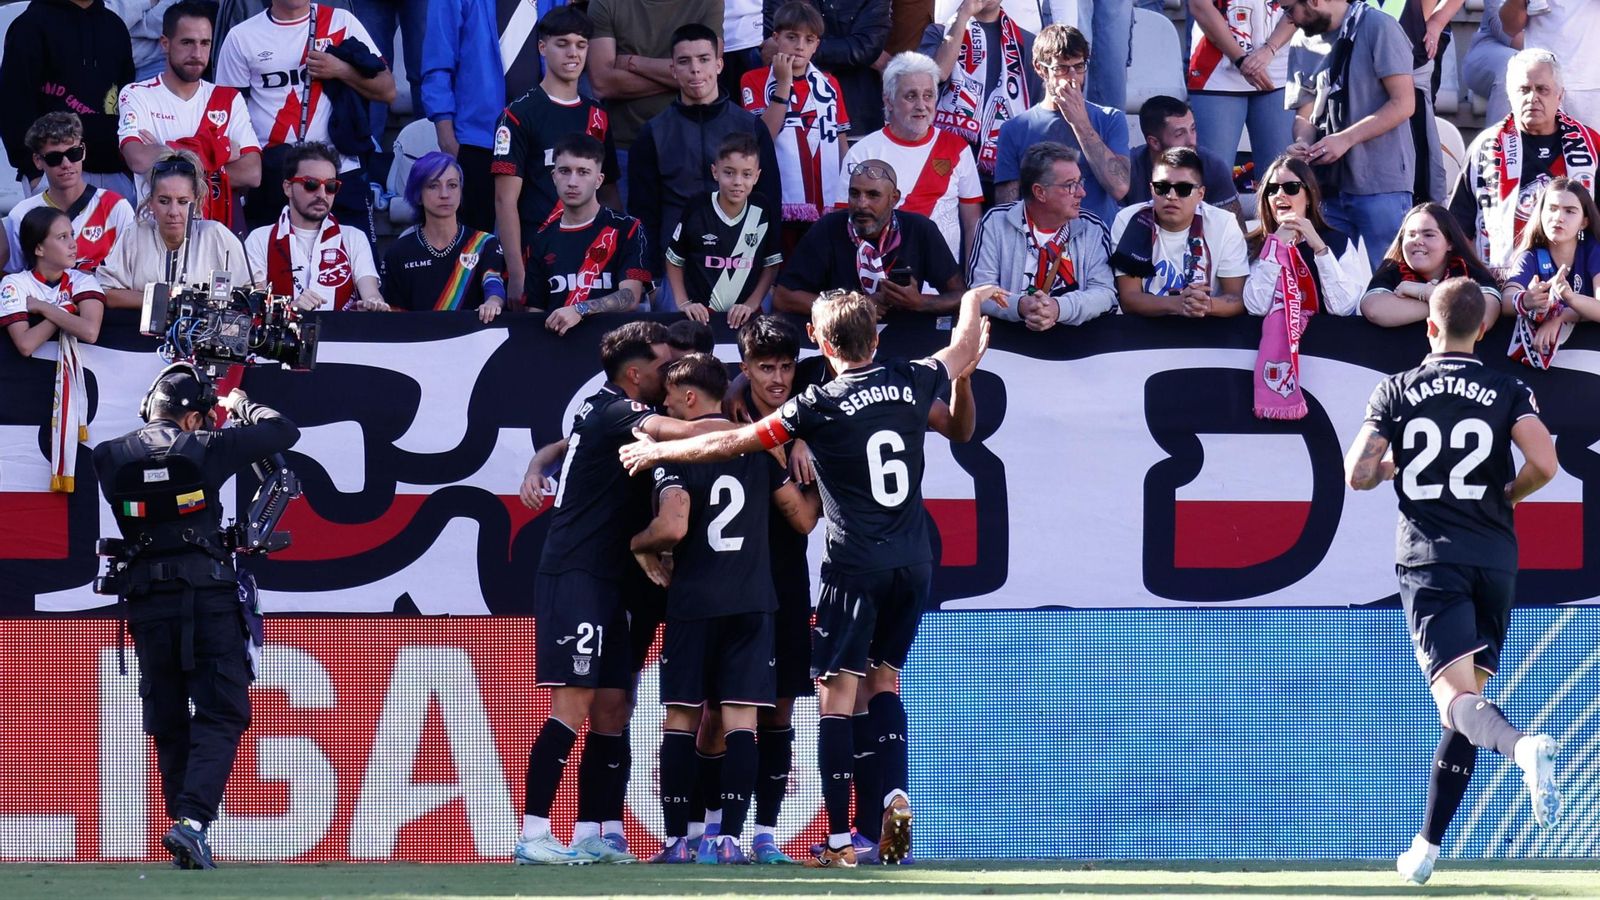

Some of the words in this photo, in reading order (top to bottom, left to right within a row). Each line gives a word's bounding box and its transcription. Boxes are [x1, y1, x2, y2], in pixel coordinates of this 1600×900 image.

[971, 21, 983, 65] NUESTRA
[936, 112, 979, 131] RAYO
[404, 259, 432, 269] KELME
[548, 271, 612, 293] DIGI
[839, 385, 900, 416] SERGIO
[902, 386, 917, 406] G.
[1403, 376, 1497, 407] NASTASIC
[553, 432, 581, 508] 1
[866, 429, 910, 508] 6
[1402, 417, 1494, 501] 22
[707, 474, 745, 552] 2
[576, 622, 603, 657] 21
[1437, 760, 1470, 775] CDL
[720, 793, 744, 801] CDL
